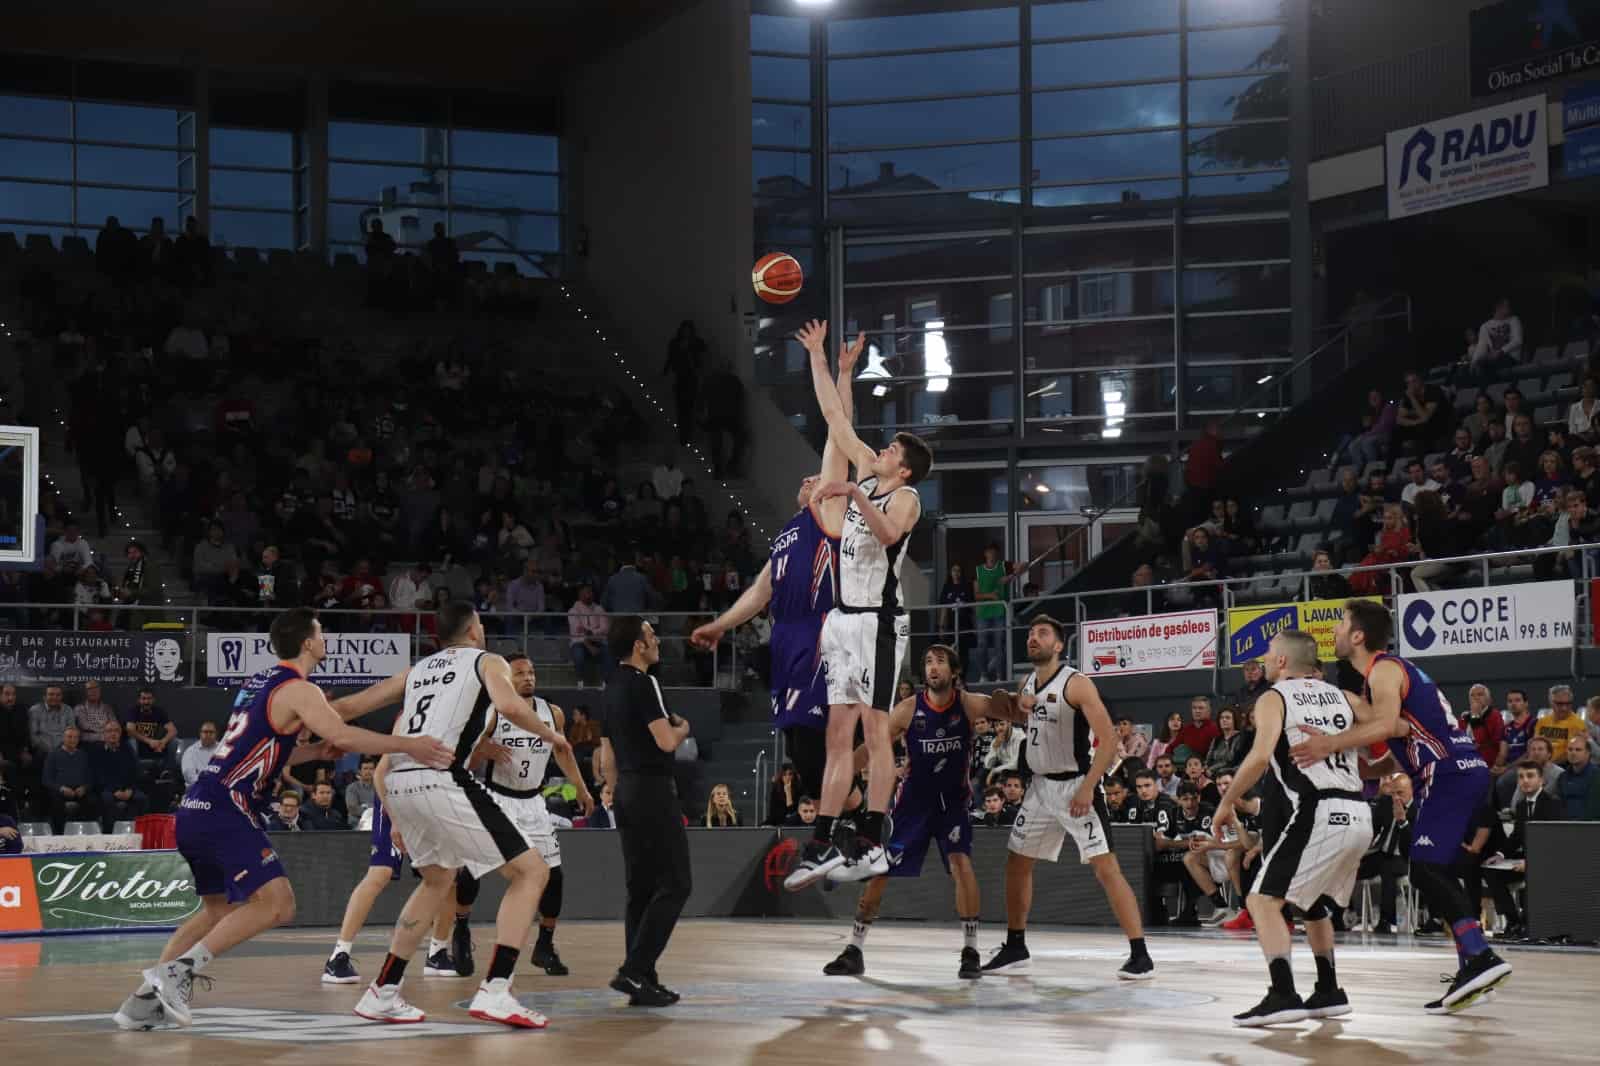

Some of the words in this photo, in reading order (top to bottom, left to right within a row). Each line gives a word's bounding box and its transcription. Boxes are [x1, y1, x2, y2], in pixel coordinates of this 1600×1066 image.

[1489, 71, 1521, 89] Obra
[1523, 56, 1563, 80] Social
[1440, 110, 1537, 166] RADU
[1304, 607, 1345, 623] LAVAN
[1442, 596, 1509, 626] COPE
[1088, 622, 1147, 644] Distribución
[1149, 623, 1161, 638] de
[1163, 619, 1210, 640] gasóleos
[1235, 636, 1254, 656] La
[1260, 613, 1292, 641] Vega
[1442, 626, 1510, 645] PALENCIA
[1519, 624, 1548, 640] 99.8
[1554, 621, 1573, 638] FM
[22, 637, 45, 648] BAR
[55, 637, 131, 649] RESTAURANTE
[26, 650, 47, 669] de
[408, 694, 436, 735] 8
[502, 737, 544, 750] RETA
[918, 735, 963, 754] TRAPA
[1030, 727, 1039, 746] 2
[518, 760, 531, 779] 3
[949, 825, 962, 844] 4
[1084, 821, 1097, 841] 2
[37, 861, 197, 903] Victor
